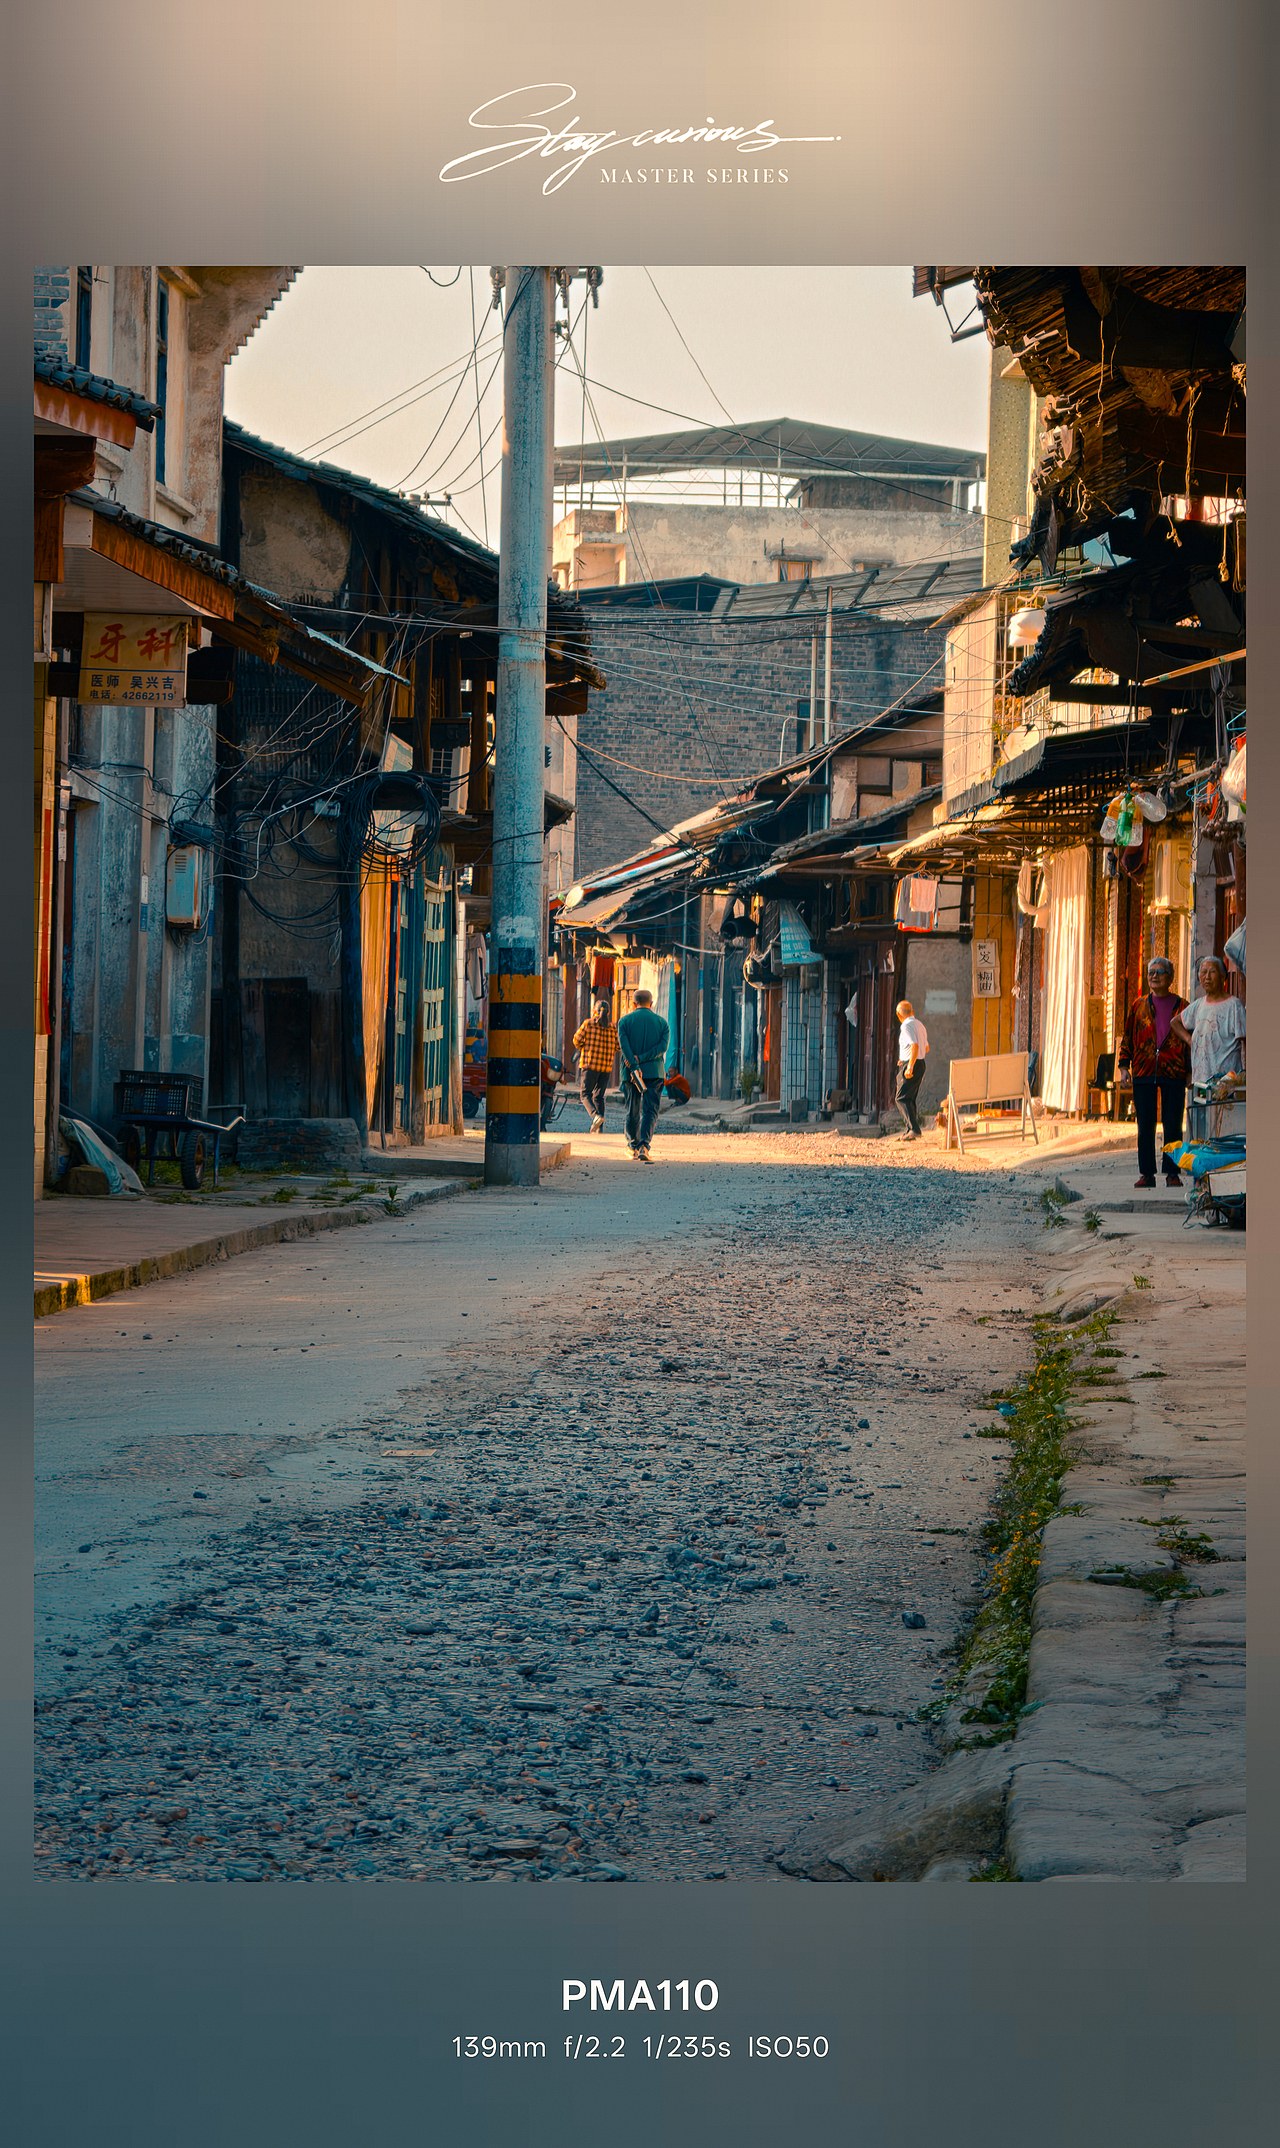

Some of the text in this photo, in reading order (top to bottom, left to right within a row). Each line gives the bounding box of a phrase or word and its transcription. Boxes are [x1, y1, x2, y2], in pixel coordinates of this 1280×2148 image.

[90, 623, 177, 666] 牙科
[91, 674, 174, 690] 医师 吴兴吉
